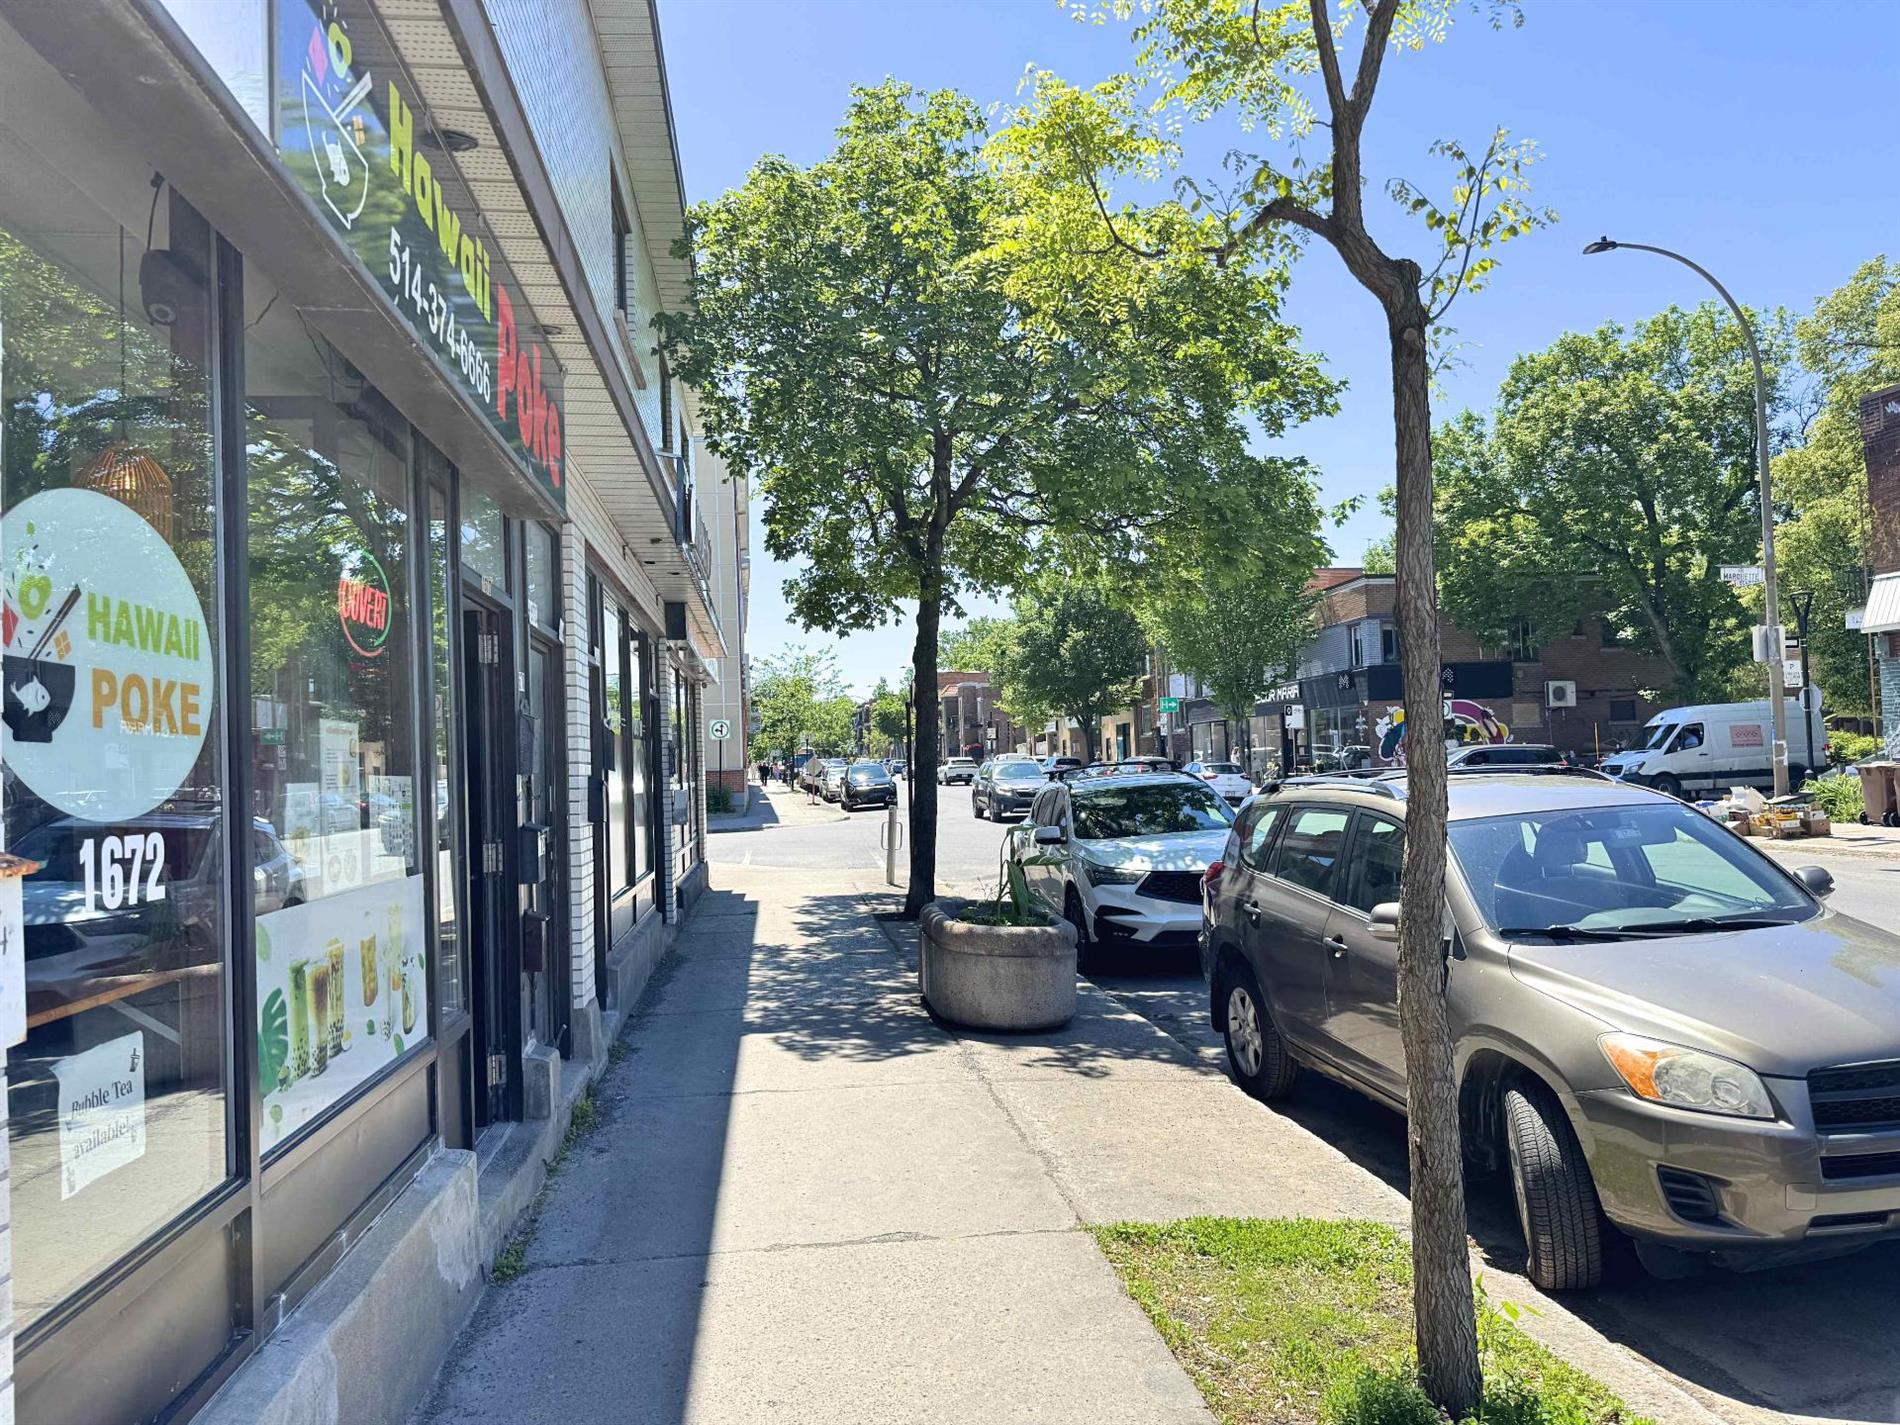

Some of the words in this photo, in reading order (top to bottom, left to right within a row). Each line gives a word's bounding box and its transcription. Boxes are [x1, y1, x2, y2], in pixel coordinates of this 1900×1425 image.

[389, 80, 491, 323] Hawaii
[497, 282, 561, 488] Poke
[389, 226, 491, 404] 514-374-6666
[338, 580, 389, 632] OUVERT
[91, 667, 201, 736] POKE
[79, 831, 166, 913] 1672
[71, 1088, 110, 1119] Bubble
[112, 1079, 133, 1099] Tea
[73, 1116, 130, 1159] available!
